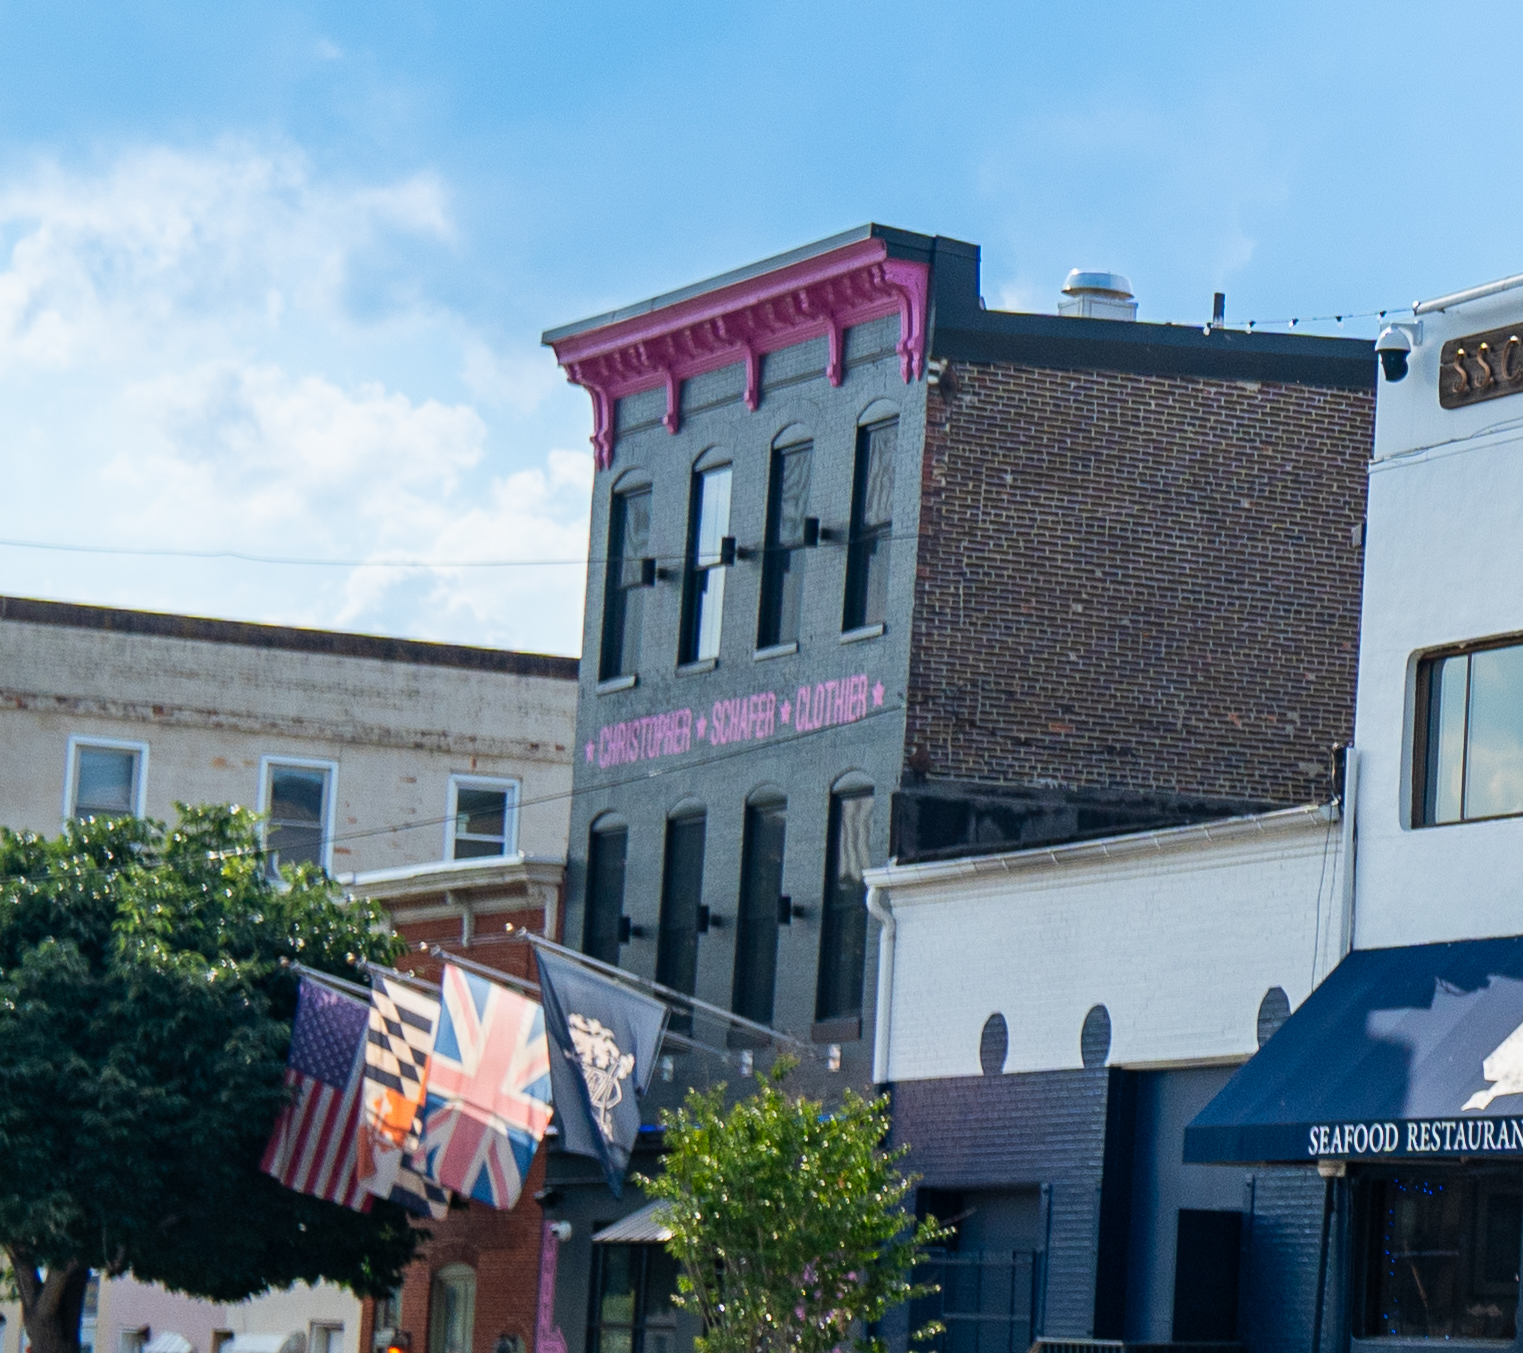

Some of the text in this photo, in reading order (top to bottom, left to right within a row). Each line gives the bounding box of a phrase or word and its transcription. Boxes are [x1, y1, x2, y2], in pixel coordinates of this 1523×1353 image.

[600, 674, 868, 768] CHRISTOPHER SCHAFER CLOTHIER
[1308, 1124, 1398, 1156] SEAFOOD
